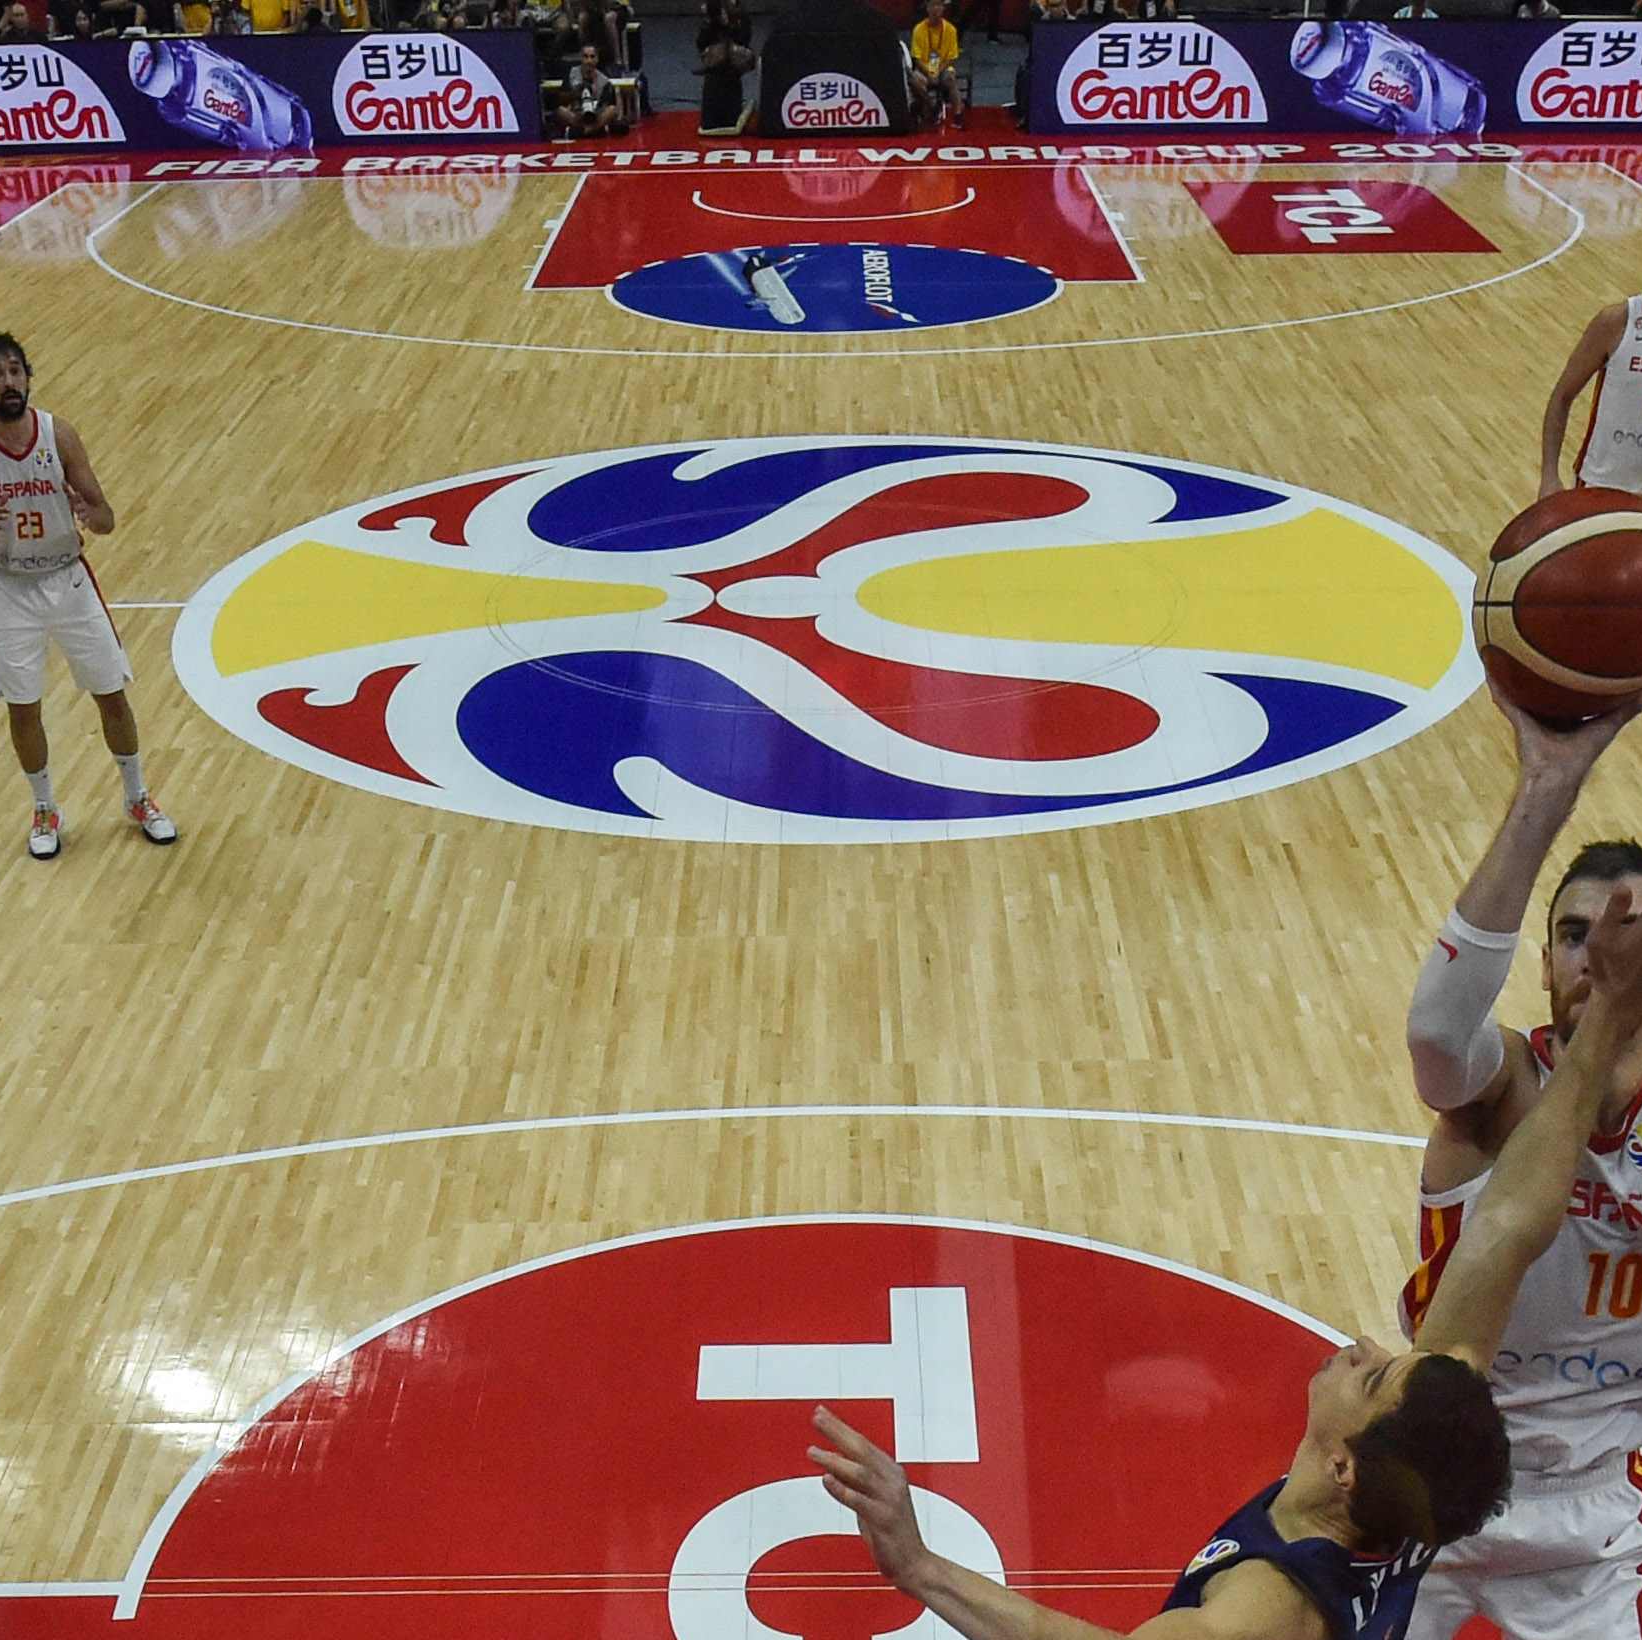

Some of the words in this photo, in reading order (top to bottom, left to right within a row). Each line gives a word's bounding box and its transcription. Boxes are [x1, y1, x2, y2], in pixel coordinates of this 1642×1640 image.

[359, 42, 463, 80] 百岁山
[1098, 32, 1214, 69] 百岁山
[799, 80, 860, 101] 百岁山
[145, 157, 322, 176] FIBA
[342, 149, 838, 172] BASKETBALL
[858, 144, 1133, 162] WORLD
[1156, 143, 1306, 159] CUP
[1329, 142, 1524, 159] 2019
[1271, 188, 1396, 244] TCL
[862, 248, 893, 303] AEROFLOT
[15, 511, 46, 541] 23
